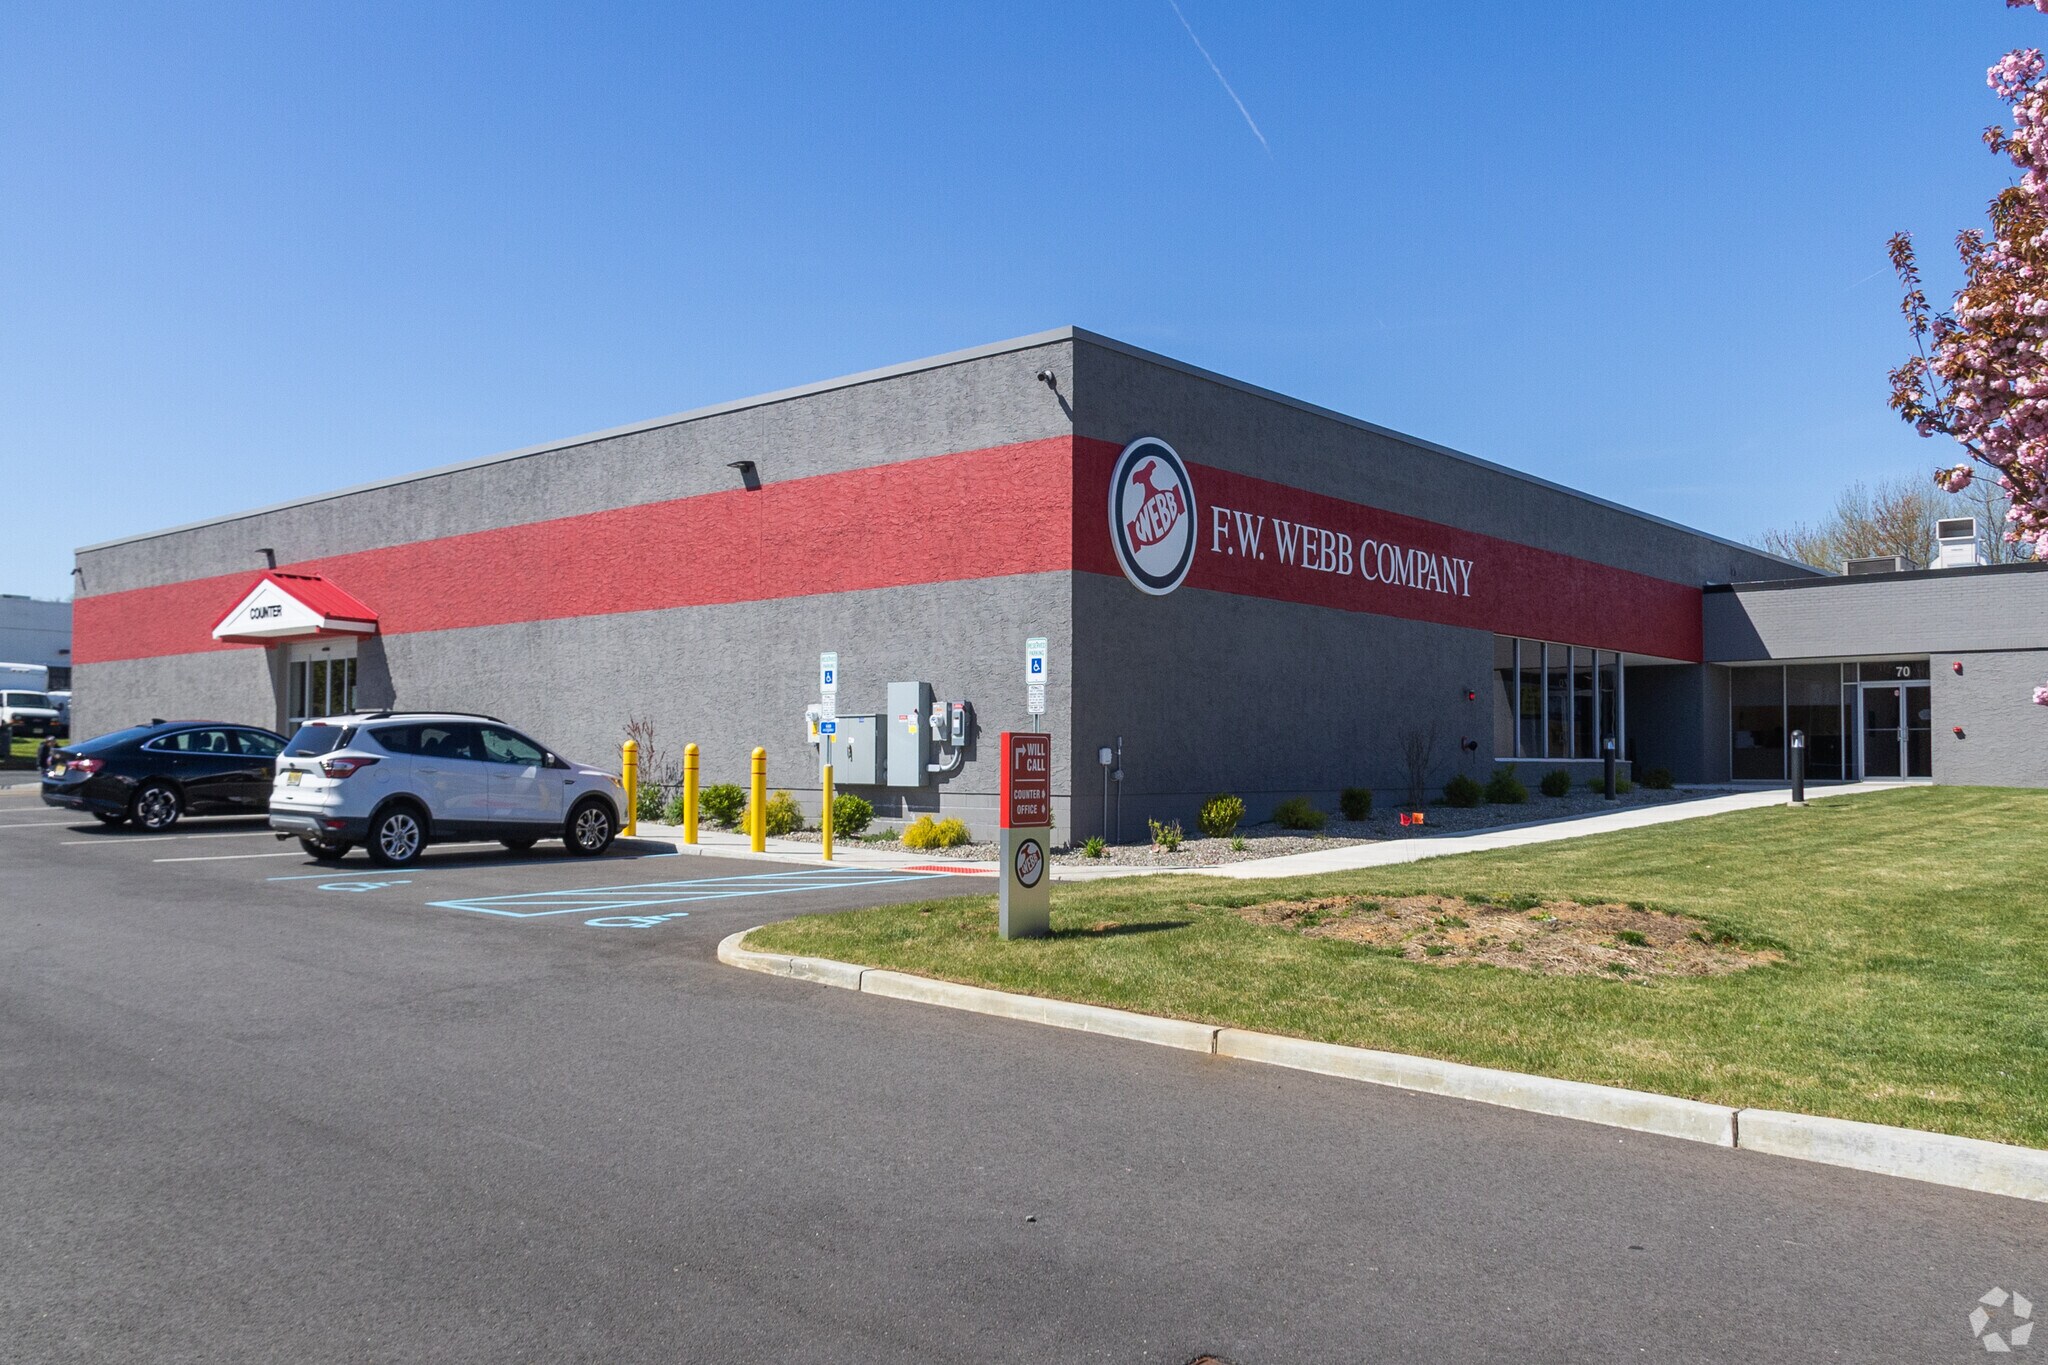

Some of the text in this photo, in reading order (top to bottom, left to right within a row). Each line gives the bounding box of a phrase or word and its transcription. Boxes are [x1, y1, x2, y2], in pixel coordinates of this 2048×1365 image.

[1135, 492, 1177, 542] WEBB
[1210, 505, 1474, 597] F.W. WEBB COMPANY
[250, 604, 282, 620] COUNTER
[1895, 666, 1911, 677] 70
[1026, 743, 1046, 756] WILL
[1026, 758, 1046, 772] CALL
[1013, 789, 1041, 800] COUNTER
[1016, 804, 1038, 815] OFFICE
